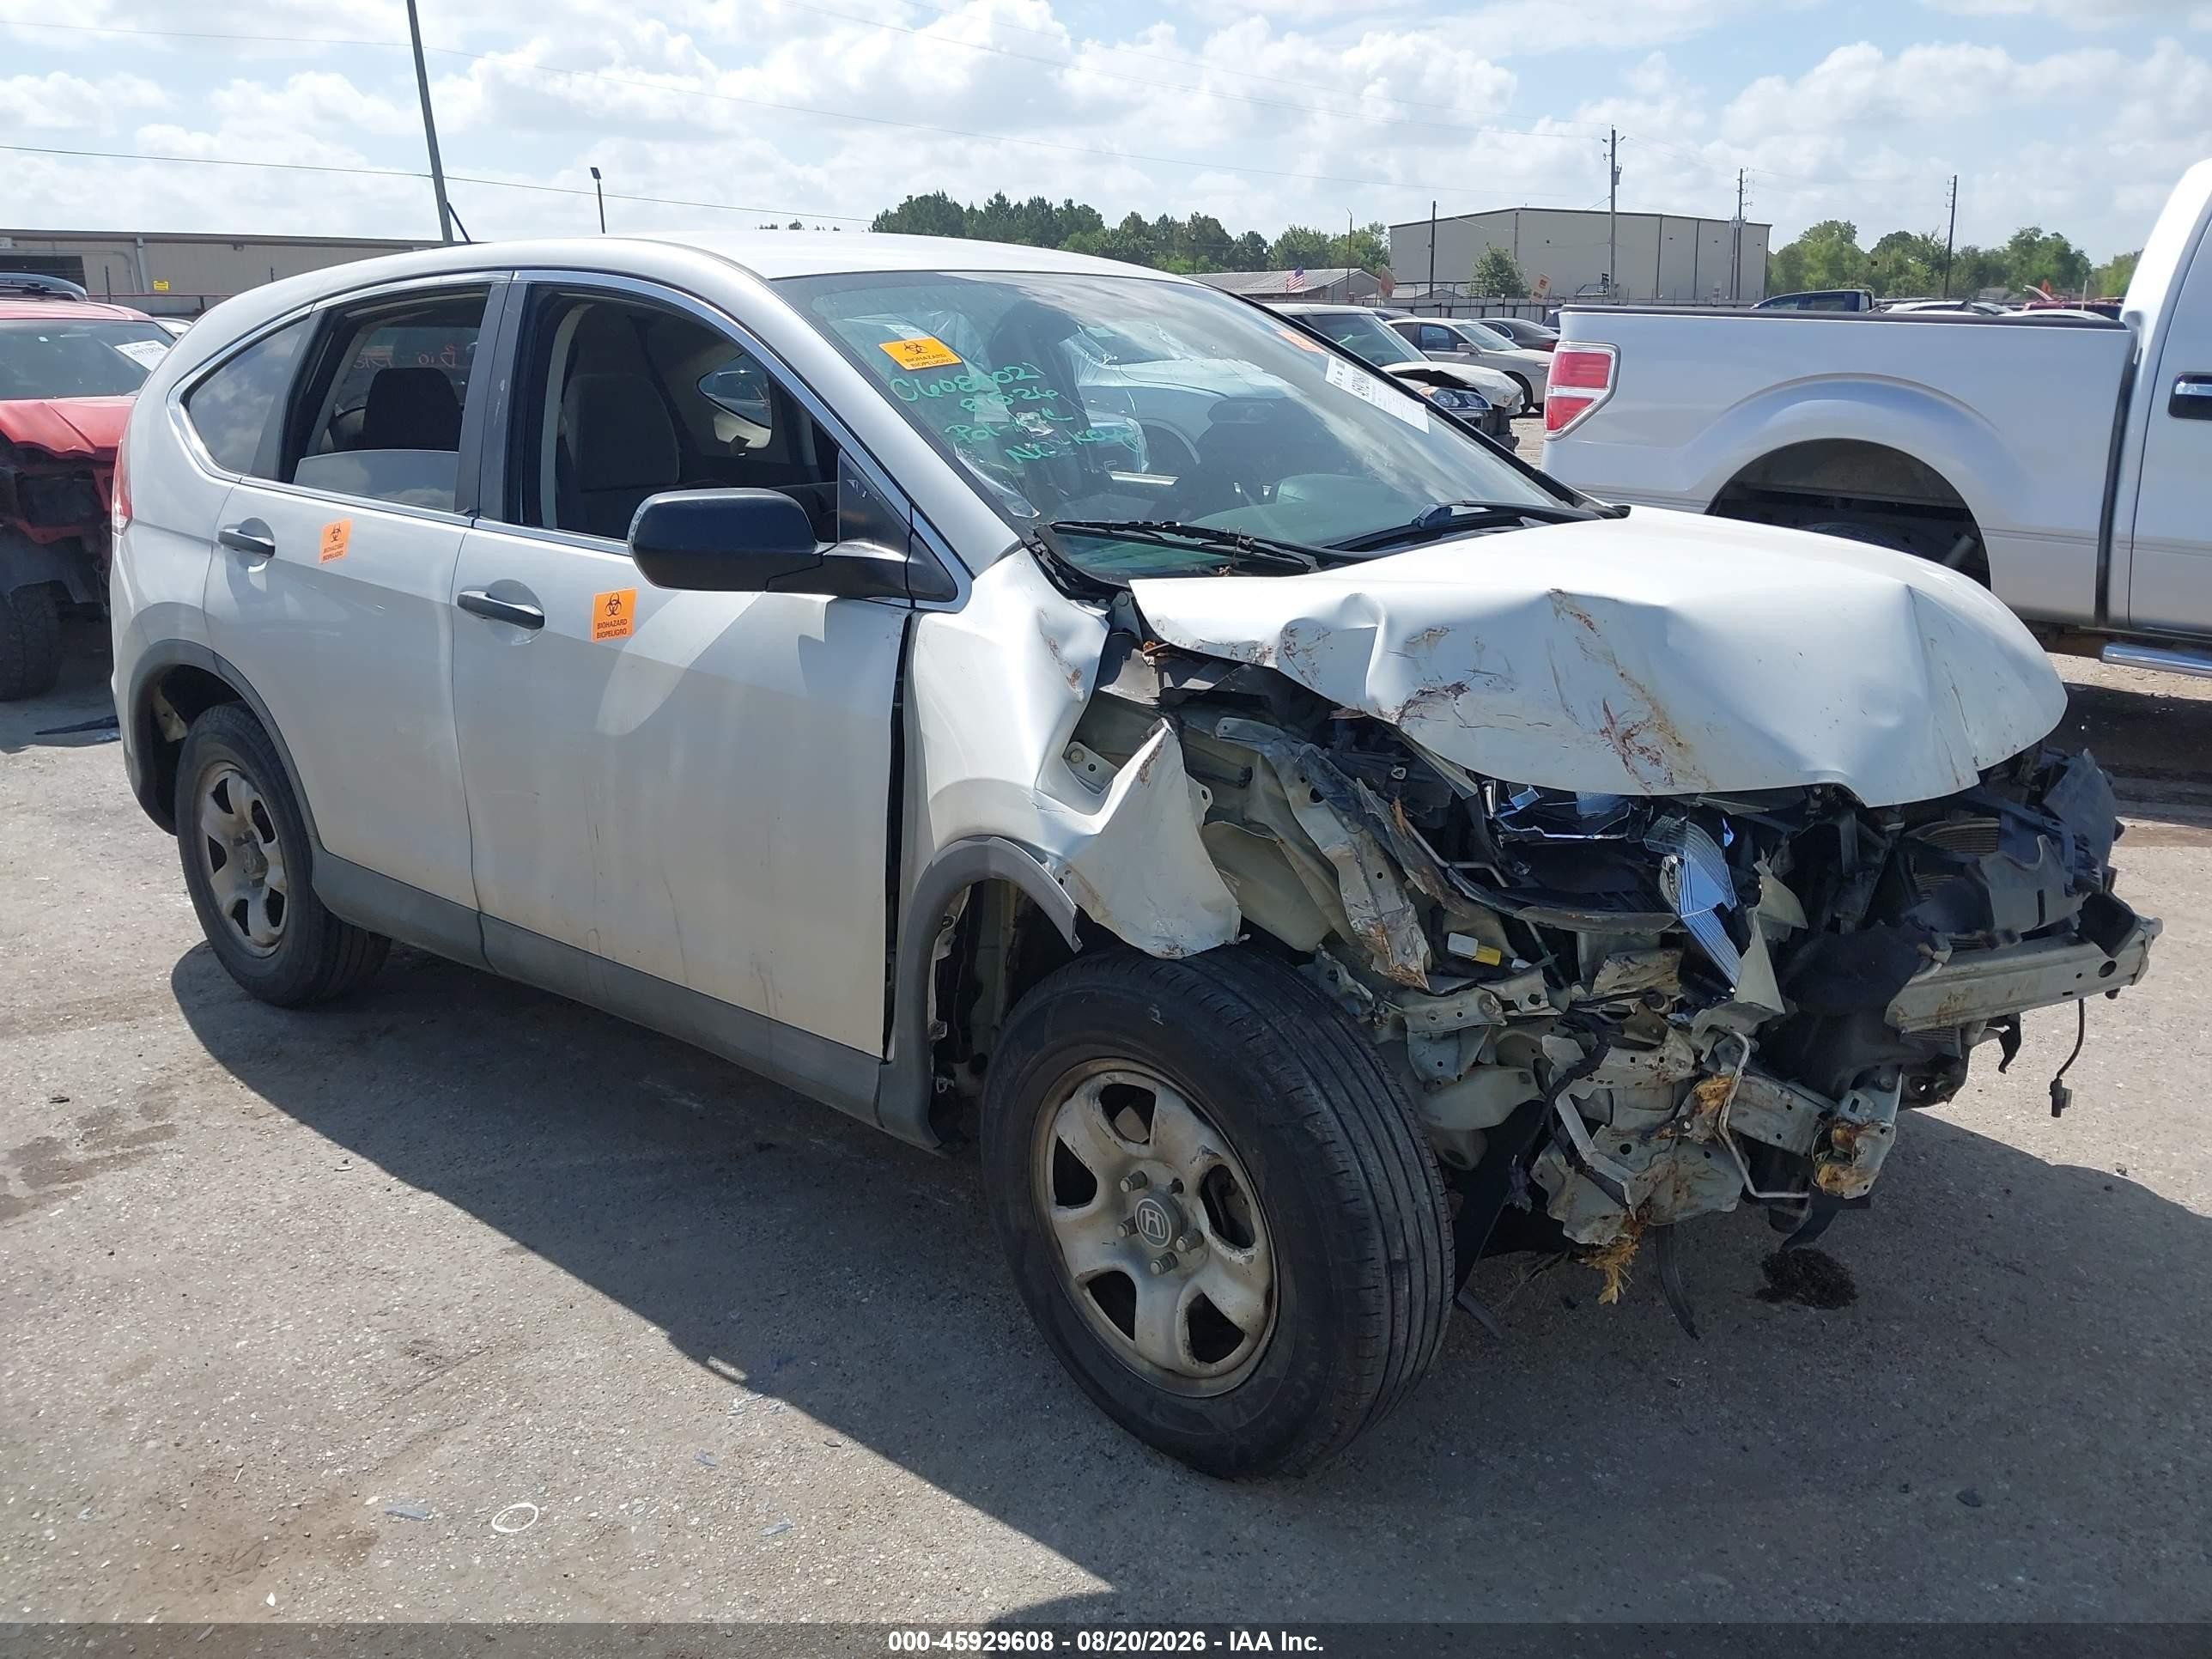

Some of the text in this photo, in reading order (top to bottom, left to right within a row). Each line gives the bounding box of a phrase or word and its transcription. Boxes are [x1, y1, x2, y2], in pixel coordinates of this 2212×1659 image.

[905, 353, 947, 363] BIOHAZARD
[597, 618, 628, 629] BIOHAZARD
[596, 628, 627, 639] BIOPELIGRO
